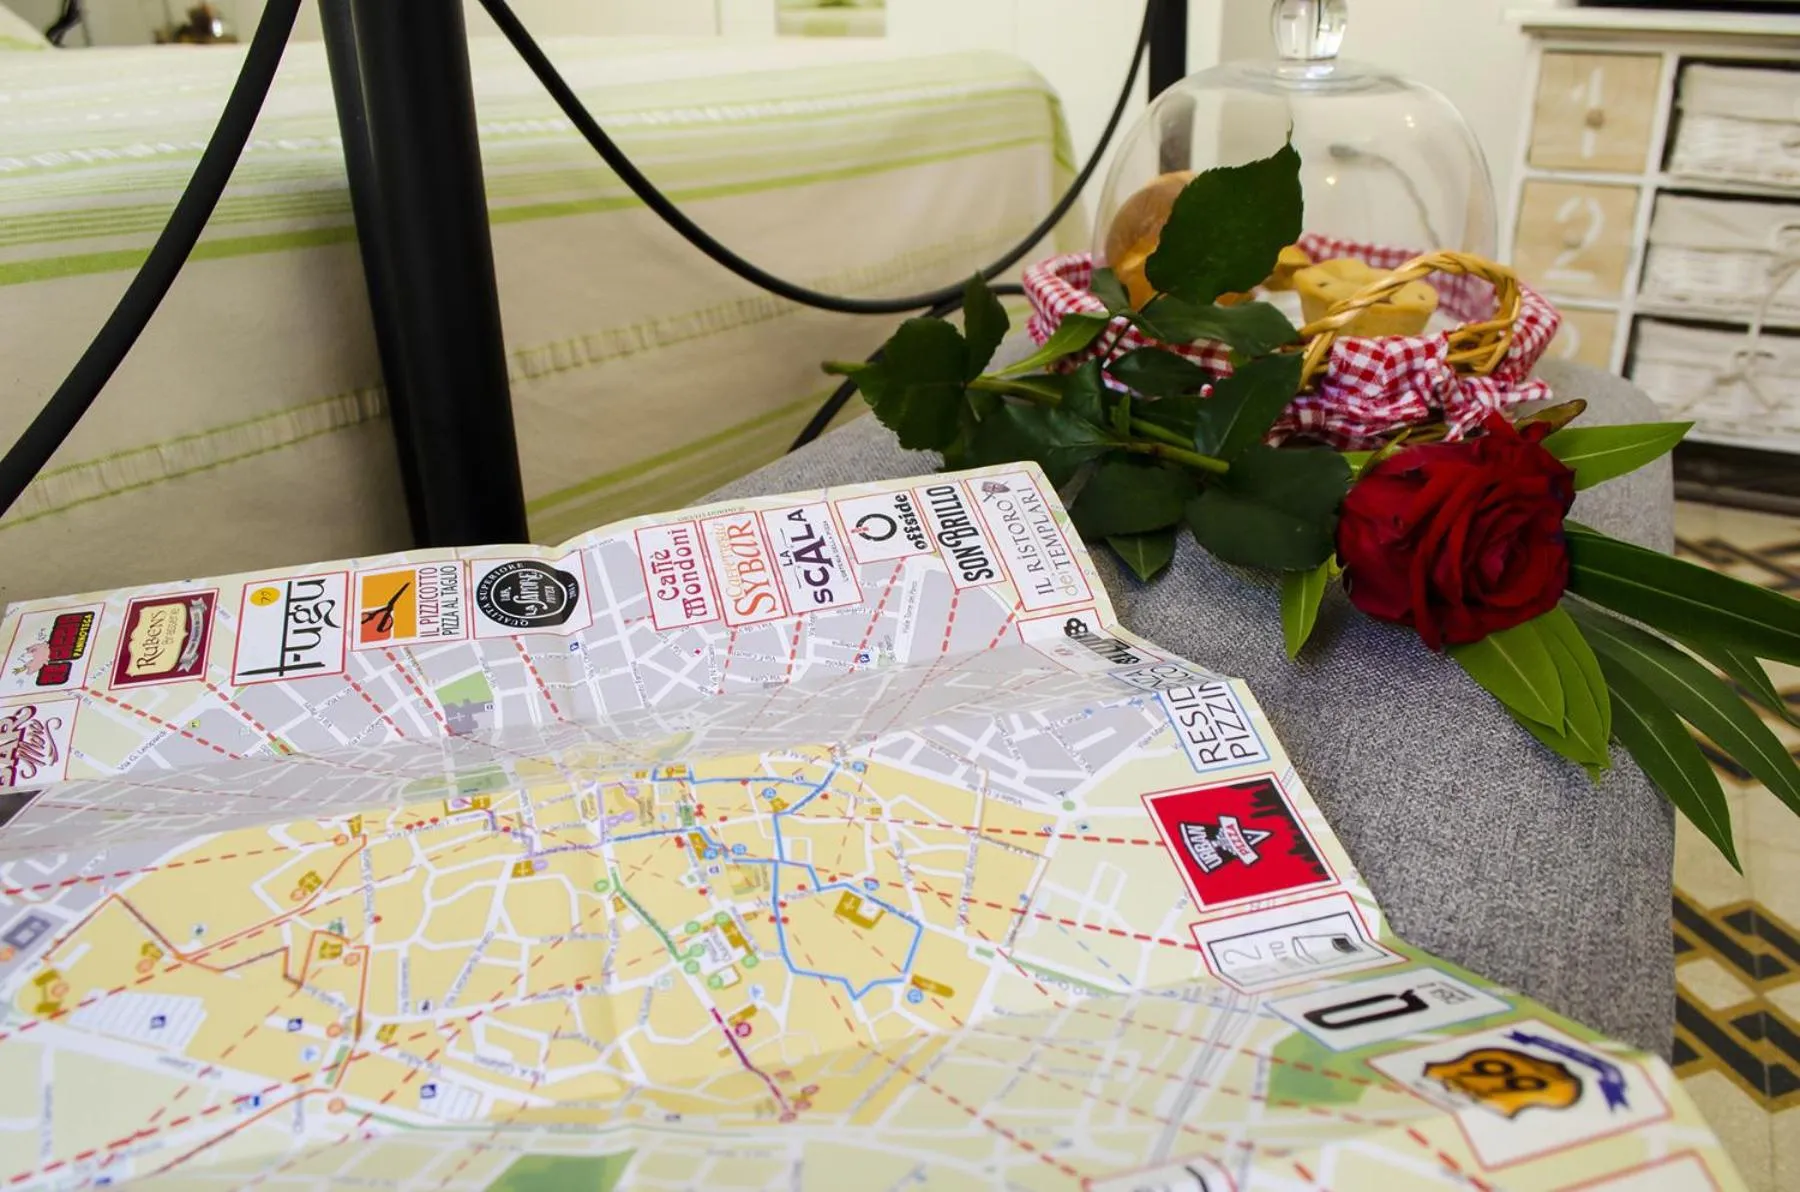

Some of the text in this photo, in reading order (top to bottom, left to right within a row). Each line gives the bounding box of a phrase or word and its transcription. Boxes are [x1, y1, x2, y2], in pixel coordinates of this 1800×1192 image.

[787, 508, 834, 604] SCALA
[895, 494, 928, 550] offside
[926, 485, 994, 582] SON BRILLO
[997, 499, 1054, 595] IL RISTORO
[1016, 487, 1071, 570] TEMPLARI
[480, 562, 524, 600] SUPERIORE
[651, 549, 680, 601] Caffè
[667, 528, 708, 619] Mondoni
[780, 550, 793, 567] LA
[419, 567, 440, 637] IL PIZZICOTTO
[440, 565, 460, 635] PIZZA AL TAGLIO
[1186, 824, 1223, 870] URBAN
[1225, 823, 1249, 856] PIZZA
